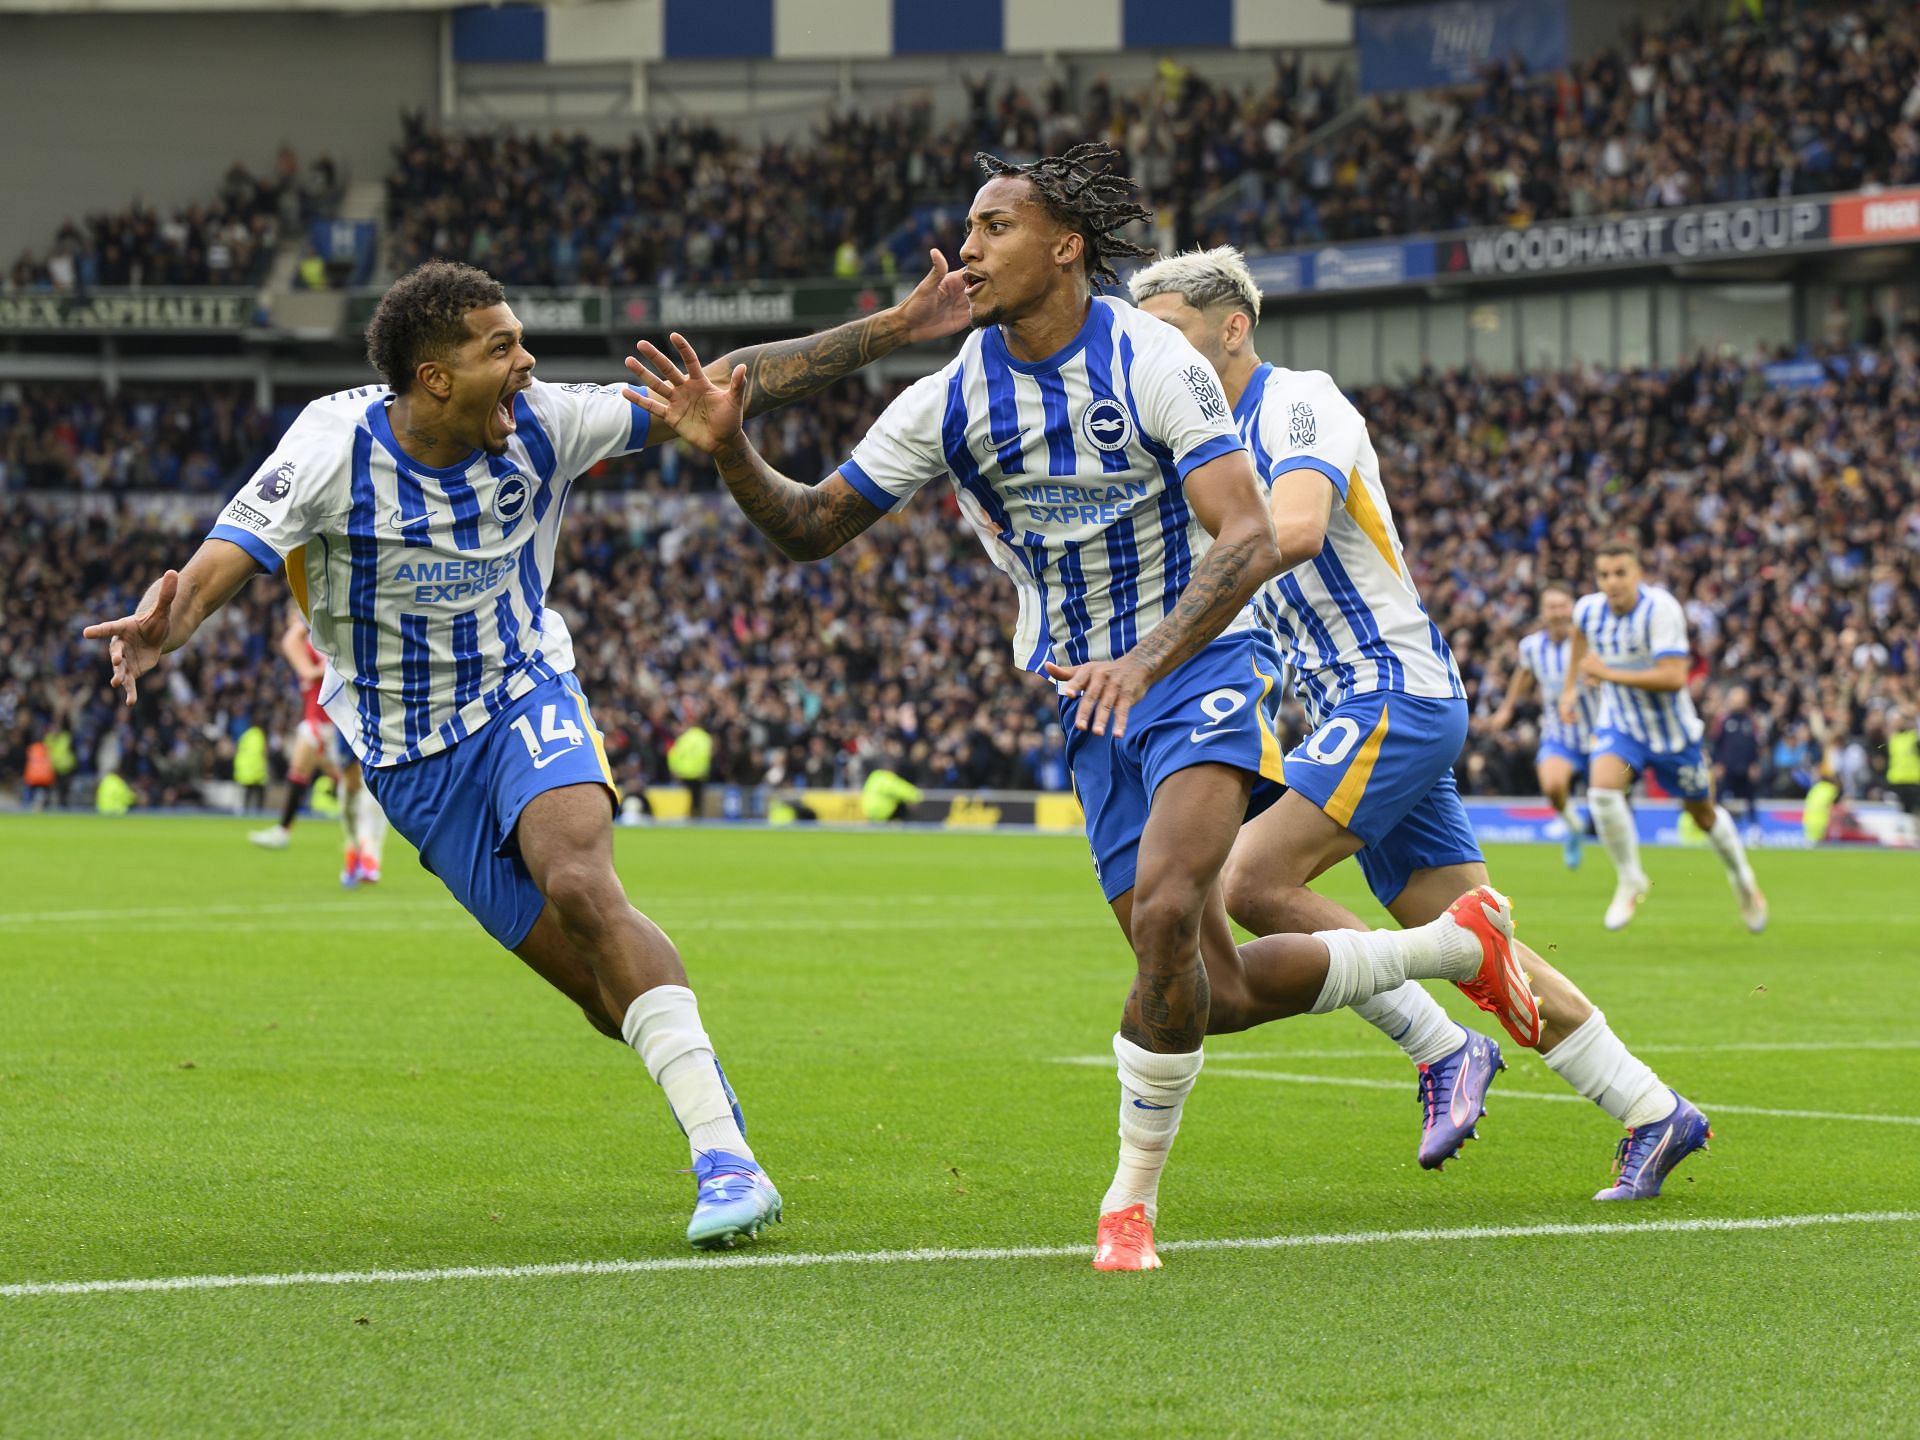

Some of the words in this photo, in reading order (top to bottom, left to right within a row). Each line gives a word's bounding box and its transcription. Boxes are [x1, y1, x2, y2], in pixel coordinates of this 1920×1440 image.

[1466, 216, 1667, 274] WOODHART
[1672, 202, 1822, 256] GROUP
[1004, 479, 1147, 505] AMERICAN
[393, 547, 520, 582] AMERIC
[1200, 688, 1247, 726] 9
[509, 704, 585, 758] 14
[1302, 717, 1360, 765] 0
